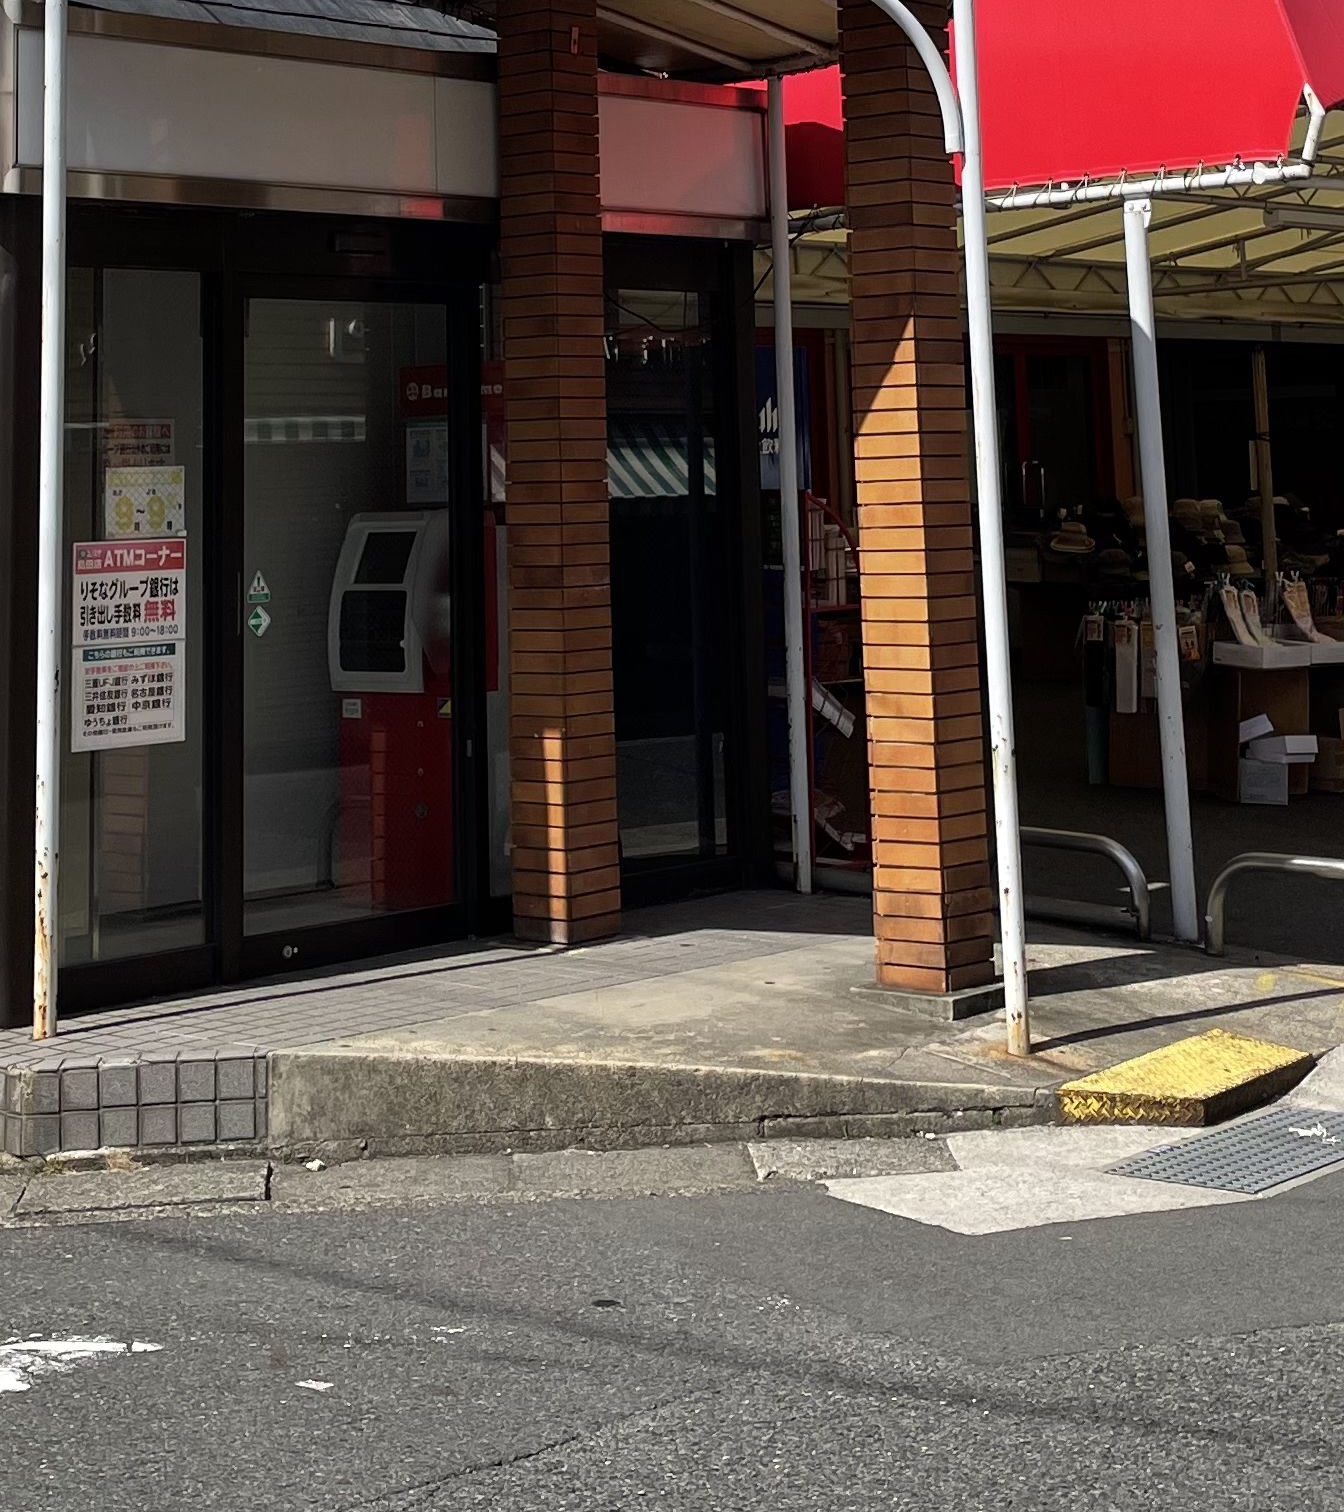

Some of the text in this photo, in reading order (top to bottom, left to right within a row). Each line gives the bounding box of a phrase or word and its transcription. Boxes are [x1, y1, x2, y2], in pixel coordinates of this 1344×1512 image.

[103, 546, 182, 568] ATMコーナー
[80, 576, 179, 601] りそなグループ銀行は
[80, 598, 176, 626] 引き出し手数料 無料
[131, 672, 173, 685] みずほ銀行
[84, 689, 129, 702] 三井住友銀行
[131, 686, 173, 699] 名古屋銀行
[86, 701, 127, 715] 愛知銀行
[131, 698, 172, 711] 中京銀行
[84, 714, 128, 728] ゆうちょ銀行
